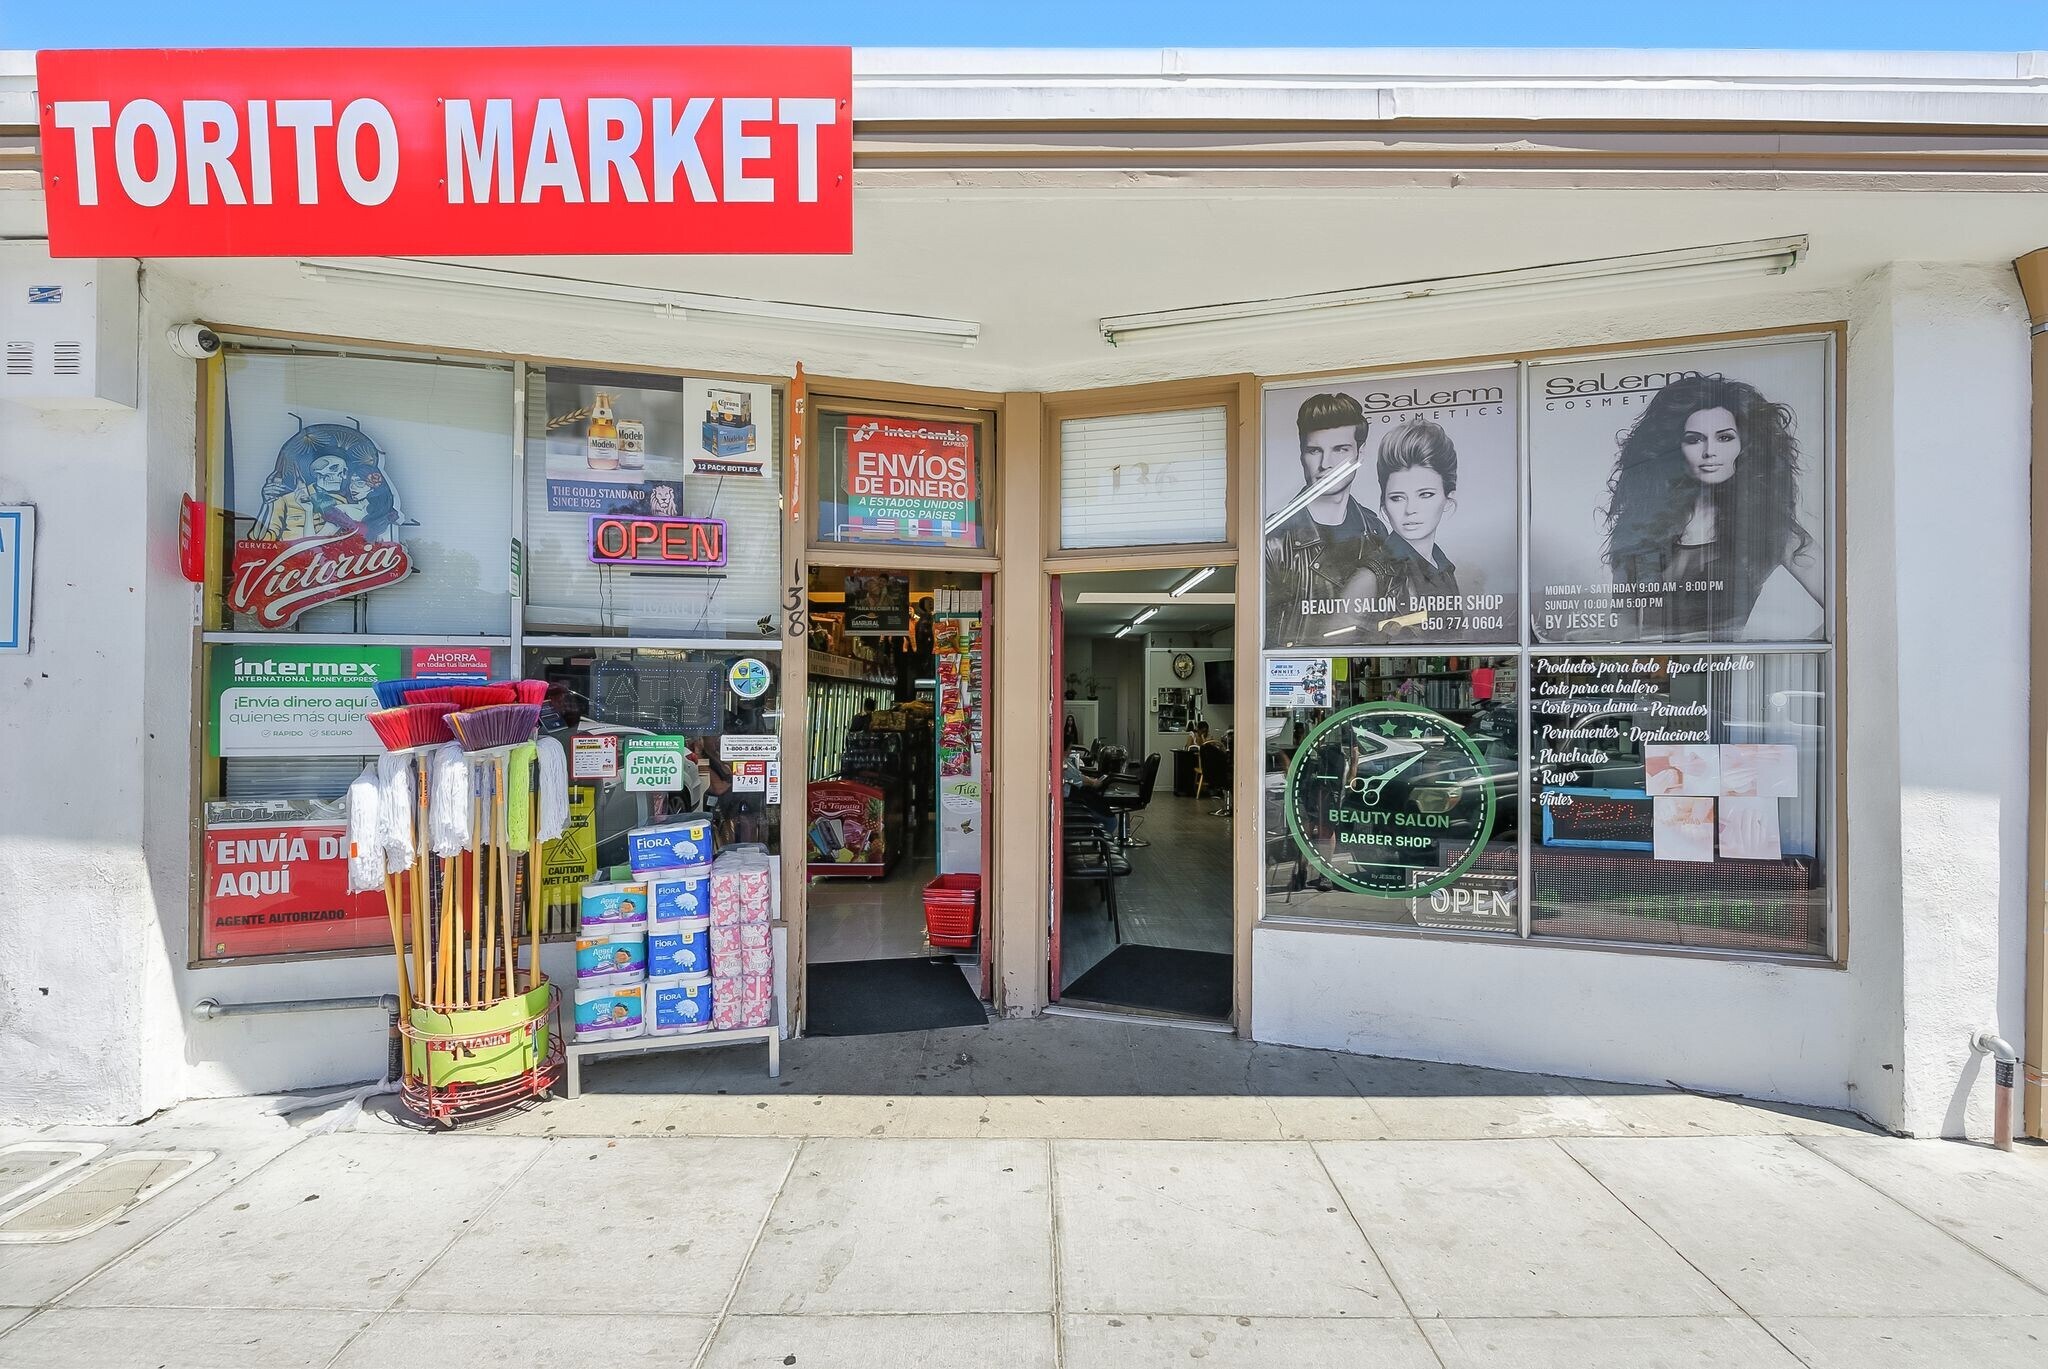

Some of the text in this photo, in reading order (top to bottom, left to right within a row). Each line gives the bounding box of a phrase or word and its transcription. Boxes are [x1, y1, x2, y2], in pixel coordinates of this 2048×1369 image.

[54, 97, 836, 207] TORITO MARKET
[1546, 394, 1648, 411] COSMET
[591, 439, 615, 449] Modelo
[727, 465, 758, 473] BOTTLES
[858, 449, 967, 481] ENVÍOS
[552, 485, 645, 500] THE GOLD STANDARD
[855, 476, 968, 499] DE DINERO
[552, 497, 601, 509] SINCE 1925
[859, 497, 964, 511] A ESTADOS UNIDOS
[868, 508, 957, 521] Y OTROS PAÍSES
[238, 542, 278, 550] CERVEZA
[597, 520, 719, 561] OPEN
[234, 537, 402, 608] Victoria
[1545, 584, 1582, 596] MONDAY
[1590, 582, 1637, 595] SATURDAY
[1639, 582, 1660, 593] 9:00
[1662, 582, 1677, 592] AM
[1685, 581, 1707, 592] 8:00
[1709, 580, 1724, 591] PM
[1301, 598, 1350, 615] BEAUTY
[1354, 597, 1396, 613] SALON
[1409, 595, 1463, 611] BARBER
[1466, 594, 1504, 610] SHOP
[1545, 597, 1663, 610] SUNDAY 10:00 AM 5:00 PM
[1421, 617, 1443, 630] 650
[1472, 615, 1503, 629] 0604
[1545, 612, 1618, 629] BY JESSE G
[427, 653, 477, 662] AHORRA
[234, 657, 377, 676] intermex
[1536, 655, 1755, 678] Productos para todo tipo de cabello
[605, 674, 709, 707] ATM
[1539, 681, 1570, 696] Corte
[1569, 683, 1601, 699] para
[233, 696, 379, 710] ¡Envía dinero aquí a
[1541, 698, 1639, 719] Corte para dama
[1650, 700, 1709, 717] Peinados
[229, 712, 290, 724] quienes
[292, 711, 325, 722] más
[1541, 724, 1620, 740] Permanentes
[1629, 726, 1711, 745] Depilaciones
[628, 738, 680, 747] intermex
[633, 753, 675, 766] ¡ENVÍA
[1540, 746, 1610, 764] Planchados
[630, 766, 678, 775] DINERO
[1541, 769, 1581, 787] Rayos
[636, 774, 672, 787] AQUÍ!
[1539, 790, 1575, 806] Tintes
[1328, 809, 1450, 829] BEAUTY SALON
[1340, 832, 1432, 848] BARBER SHOP
[217, 832, 310, 865] ENVÍA
[548, 865, 585, 876] CAUTION
[215, 864, 290, 899] AQUÍ
[542, 874, 590, 886] WET FLOOR
[1430, 887, 1513, 917] OPEN
[215, 909, 346, 927] AGENTE AUTORIZADO
